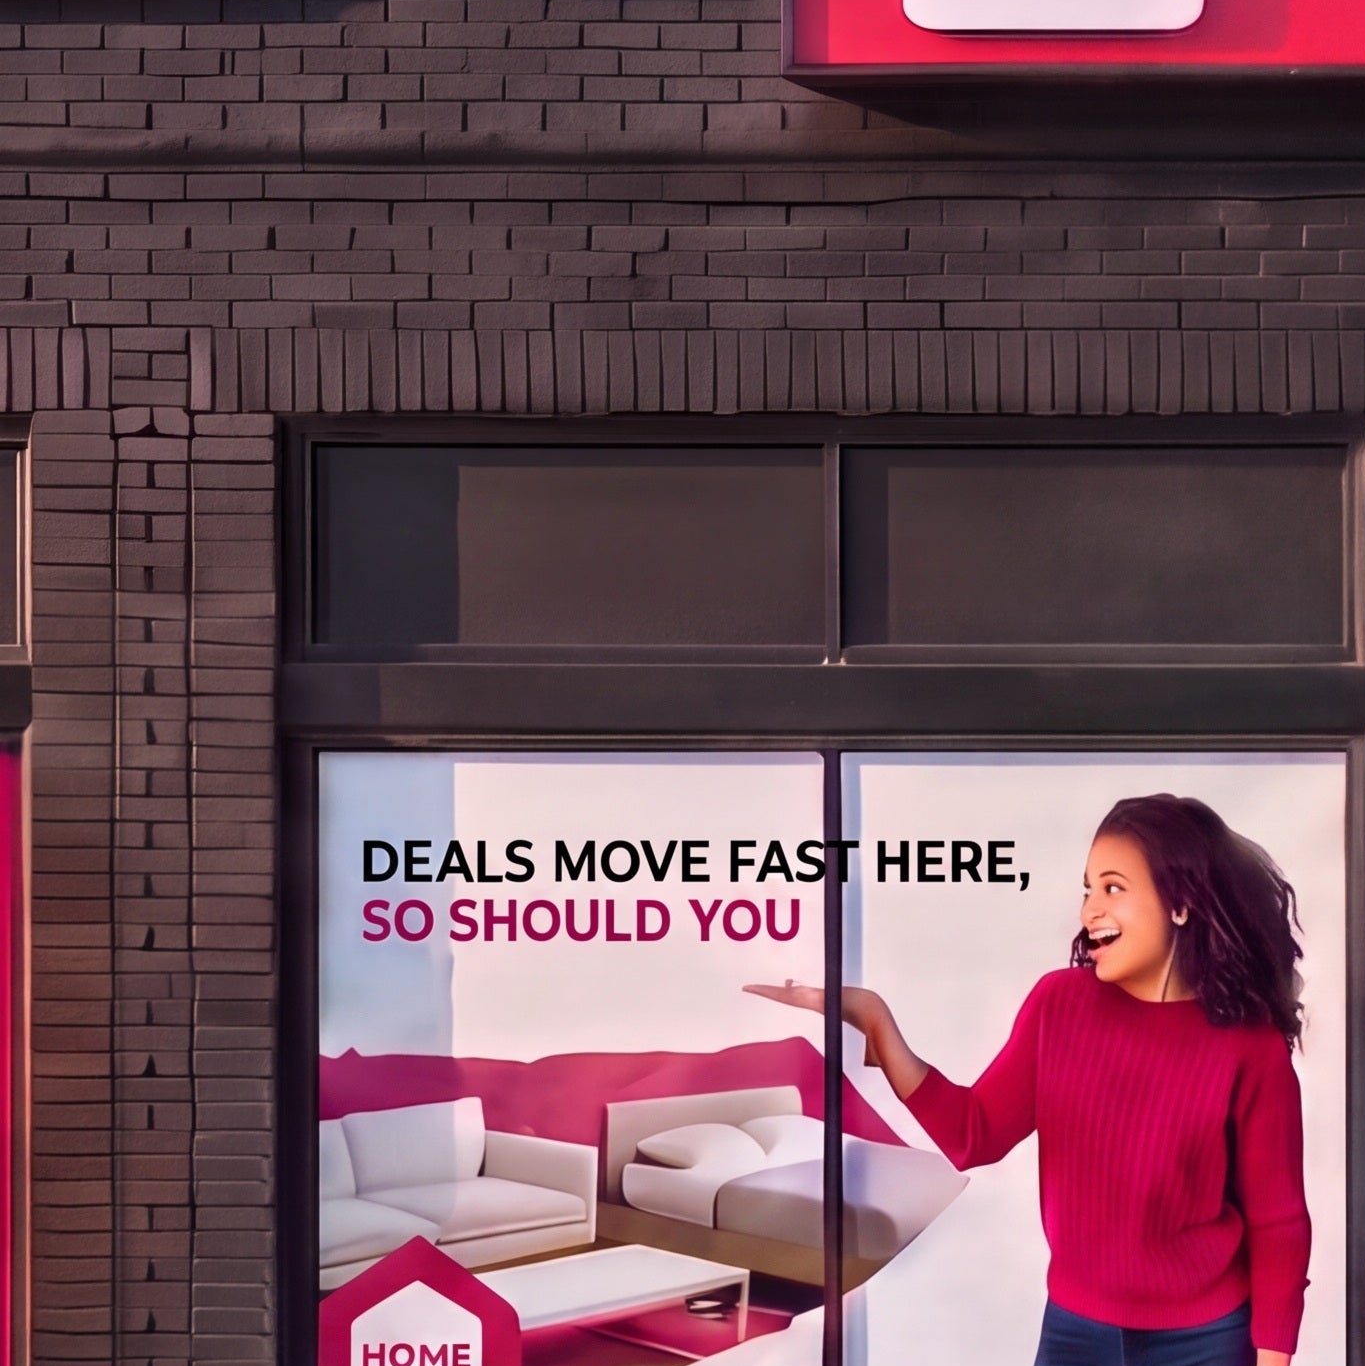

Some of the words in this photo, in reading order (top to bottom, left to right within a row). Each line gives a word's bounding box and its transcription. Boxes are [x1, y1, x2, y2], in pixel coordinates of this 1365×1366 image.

[362, 839, 535, 883] DEALS
[555, 840, 711, 883] MOVE
[729, 839, 860, 883] FAST
[877, 840, 1030, 891] HERE,
[362, 898, 435, 942] SO
[449, 898, 671, 942] SHOULD
[689, 898, 800, 942] YOU
